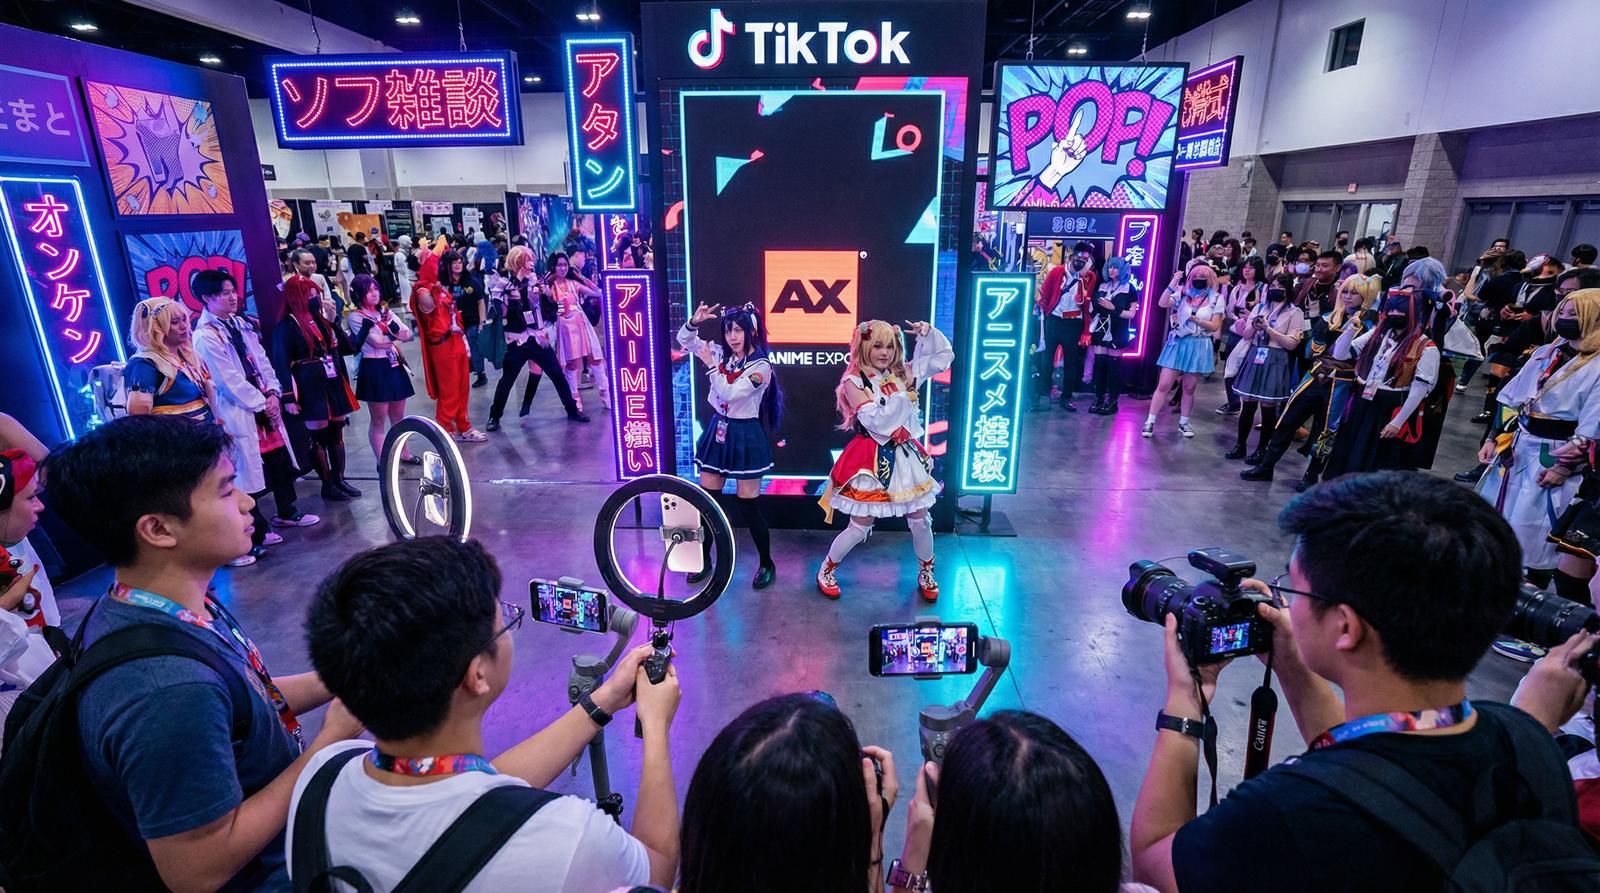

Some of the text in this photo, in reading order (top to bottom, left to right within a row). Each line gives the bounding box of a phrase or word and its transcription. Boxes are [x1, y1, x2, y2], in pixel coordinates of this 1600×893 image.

[745, 22, 911, 64] TikTok
[0, 98, 71, 136] まと
[282, 67, 501, 130] ソフ雑談
[576, 53, 624, 198] アタン
[1007, 79, 1176, 178] POP!
[24, 194, 101, 364] オンケン
[770, 279, 851, 314] AX
[768, 352, 813, 365] ANIME
